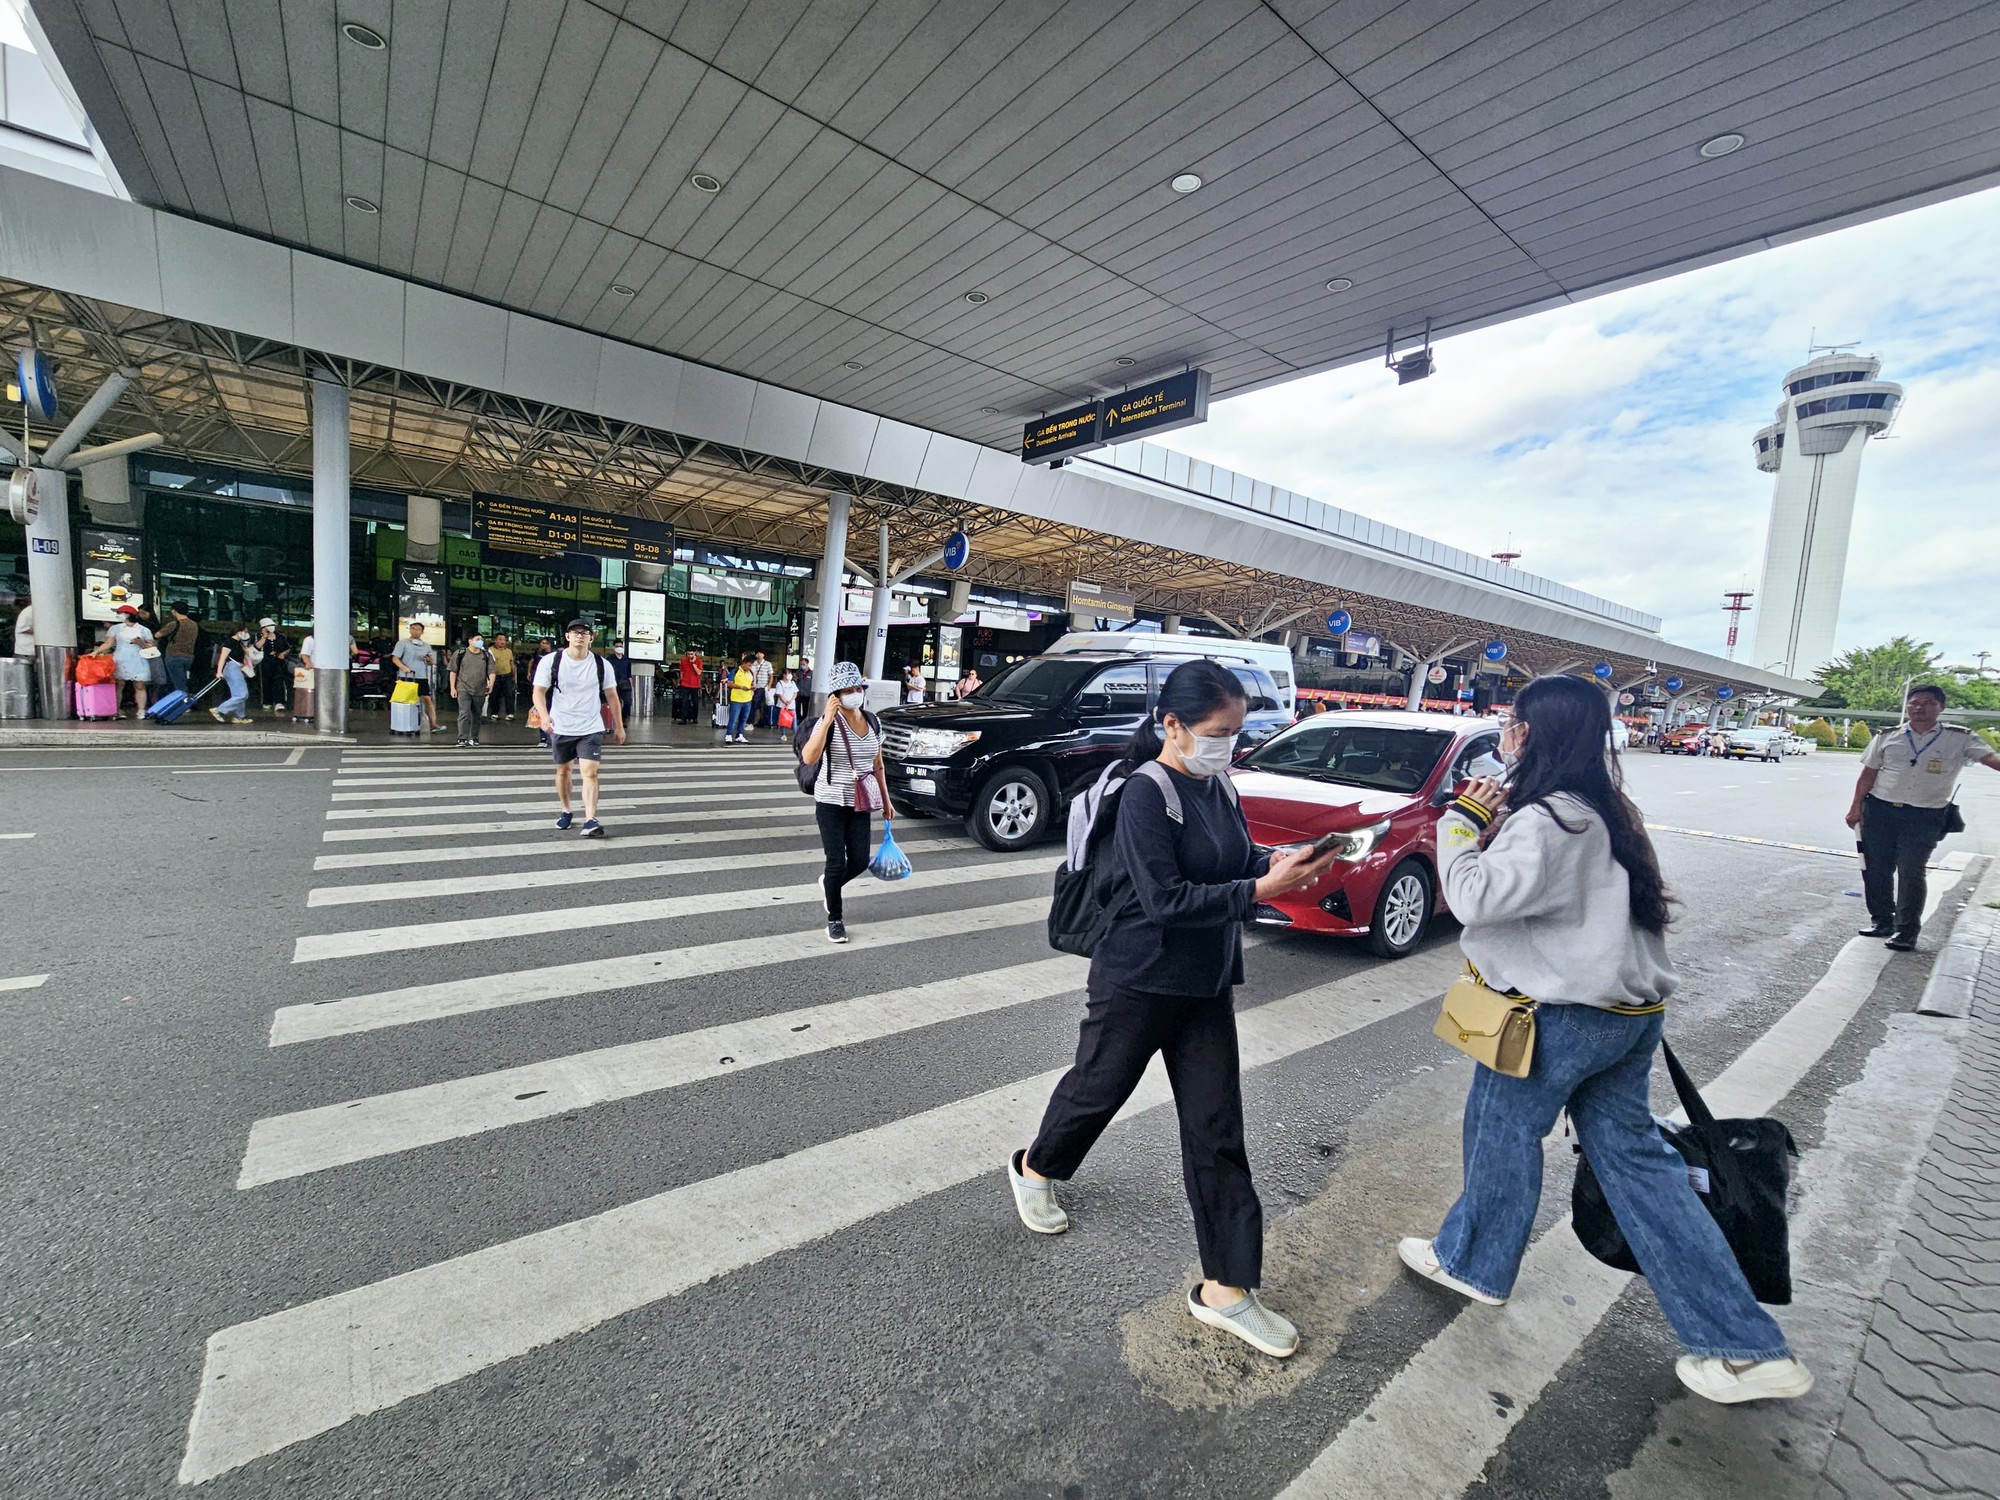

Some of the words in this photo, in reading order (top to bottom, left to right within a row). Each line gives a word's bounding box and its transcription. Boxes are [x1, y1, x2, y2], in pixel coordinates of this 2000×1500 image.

[1121, 403, 1131, 412] GA
[1132, 394, 1153, 410] QUỐC
[1154, 389, 1164, 403] TẾ
[1120, 406, 1158, 423] International
[1158, 398, 1187, 412] Terminal
[1036, 429, 1045, 437] GA
[1058, 418, 1078, 431] TRONG
[1078, 412, 1096, 425] NƯỚC
[1035, 436, 1057, 447] Domestic
[1058, 430, 1077, 440] Arrivals
[549, 512, 577, 524] A1-A3
[548, 530, 577, 541] D1-D4
[33, 539, 58, 554] A-09
[633, 543, 660, 554] D5-D8
[944, 546, 957, 557] VIB
[1107, 600, 1133, 615] Ginseng
[1328, 619, 1342, 627] VIB
[1486, 646, 1498, 654] VIB
